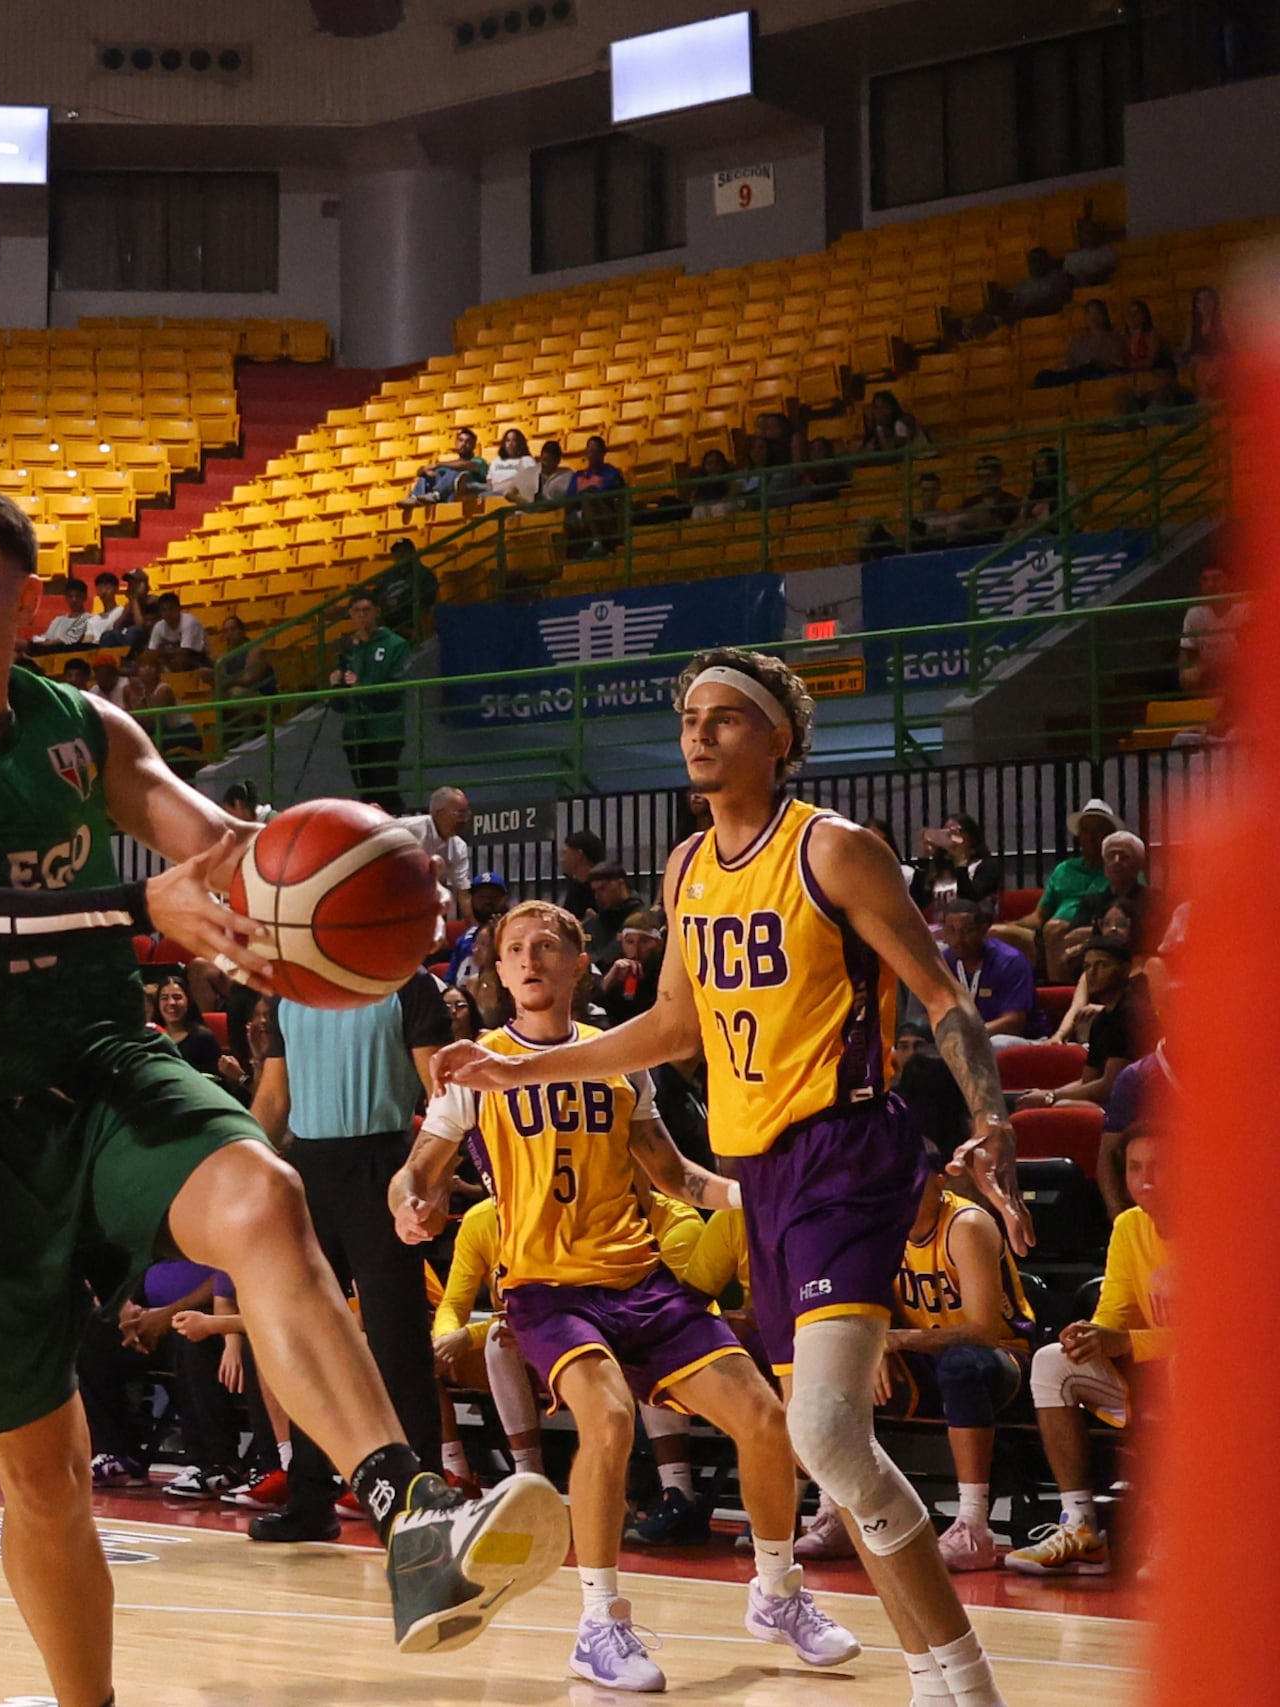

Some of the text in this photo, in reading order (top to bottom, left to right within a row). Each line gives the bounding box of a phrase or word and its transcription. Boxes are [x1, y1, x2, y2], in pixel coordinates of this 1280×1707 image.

[739, 183, 752, 208] 9
[473, 807, 537, 836] PALCO 2
[682, 910, 790, 990] UCB
[503, 1081, 615, 1137] UCB
[553, 1148, 576, 1204] 5
